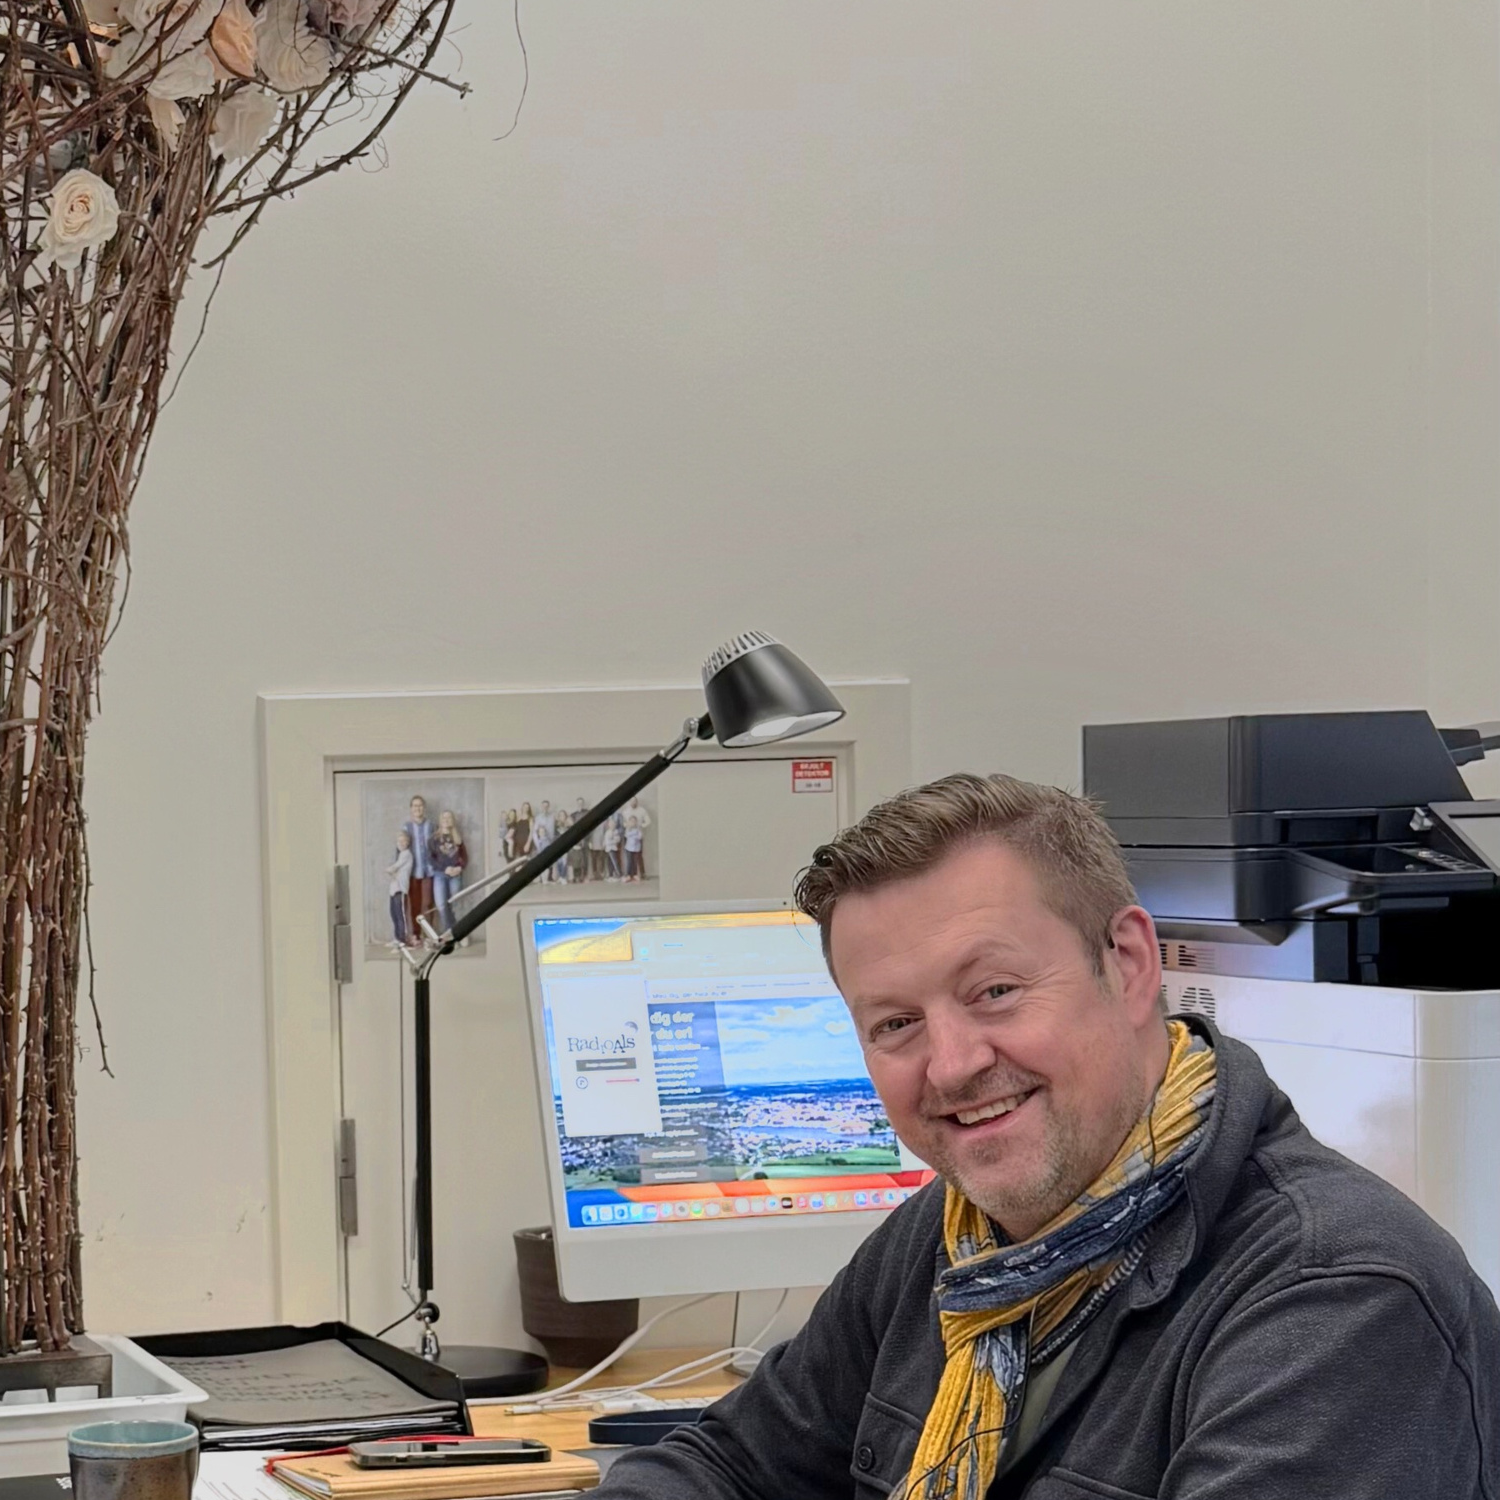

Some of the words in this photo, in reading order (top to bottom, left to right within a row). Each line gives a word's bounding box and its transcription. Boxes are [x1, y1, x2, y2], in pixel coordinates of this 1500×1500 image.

[650, 1011, 671, 1027] dig
[672, 1010, 695, 1024] der
[655, 1027, 674, 1040] du
